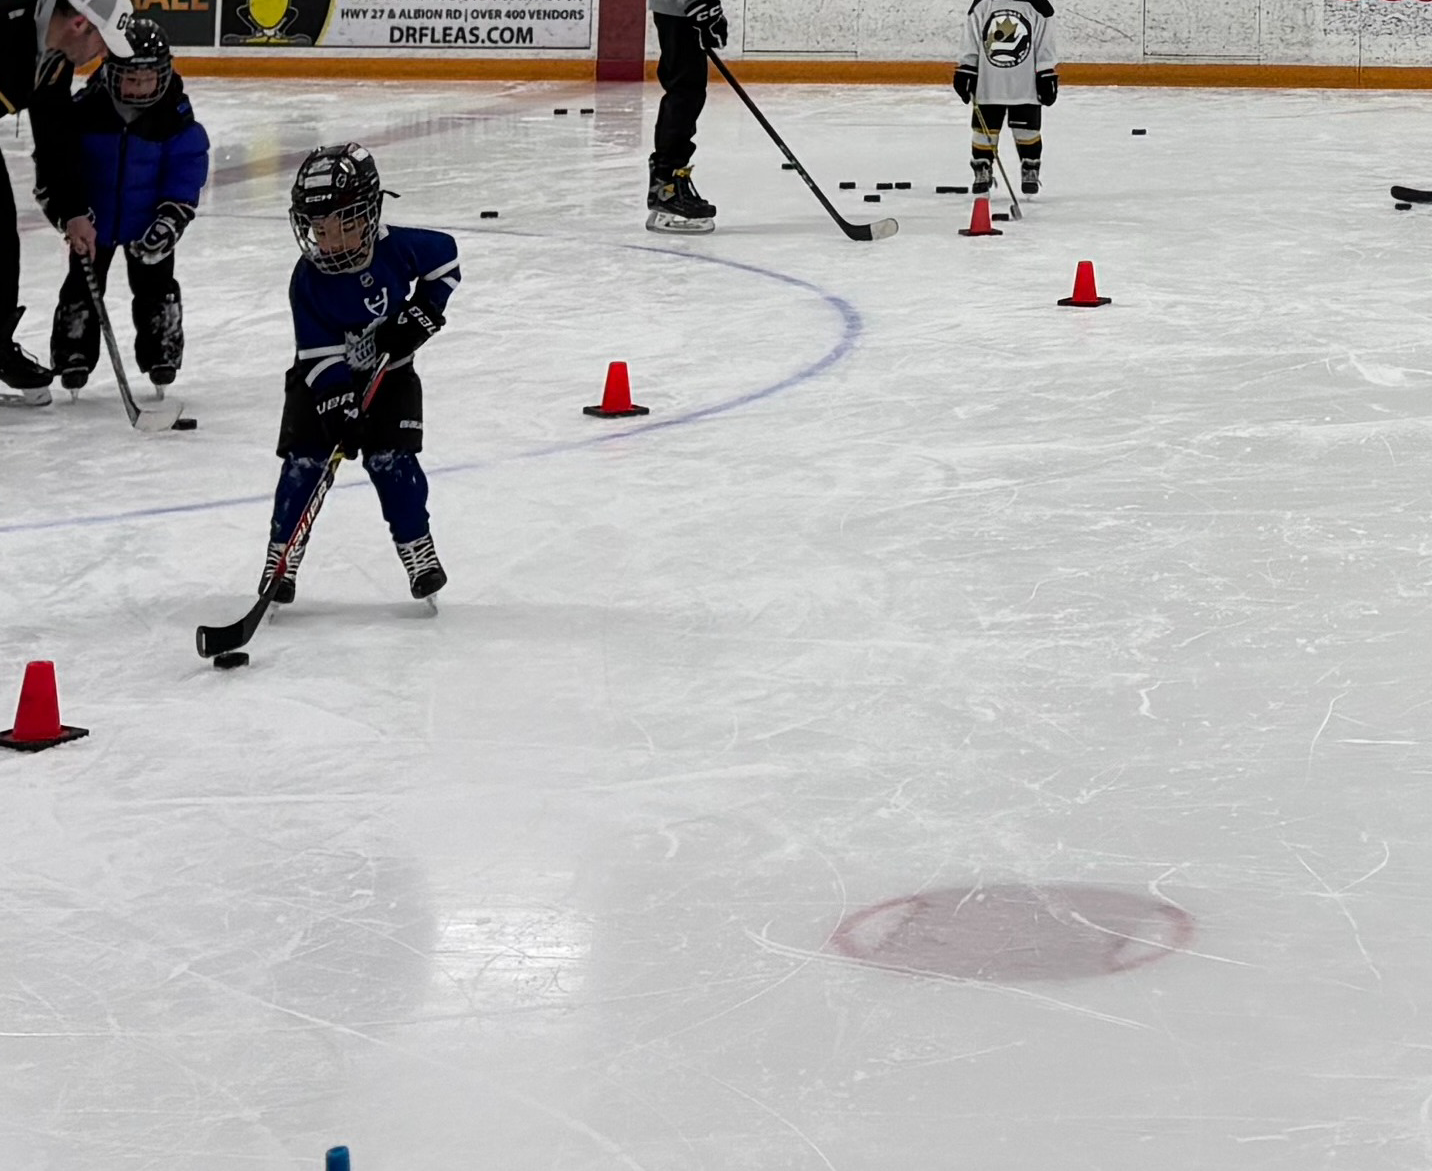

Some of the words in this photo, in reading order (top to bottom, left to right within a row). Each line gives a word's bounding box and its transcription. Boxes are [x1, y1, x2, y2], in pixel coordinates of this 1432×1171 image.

[341, 9, 368, 20] HWY
[371, 9, 385, 20] 27
[387, 9, 396, 20] &
[399, 9, 442, 20] ALBION
[445, 9, 463, 20] RD
[470, 9, 502, 20] OVER
[504, 9, 526, 21] 400
[528, 9, 585, 21] VENDORS
[389, 26, 534, 45] DRFLEAS.COM
